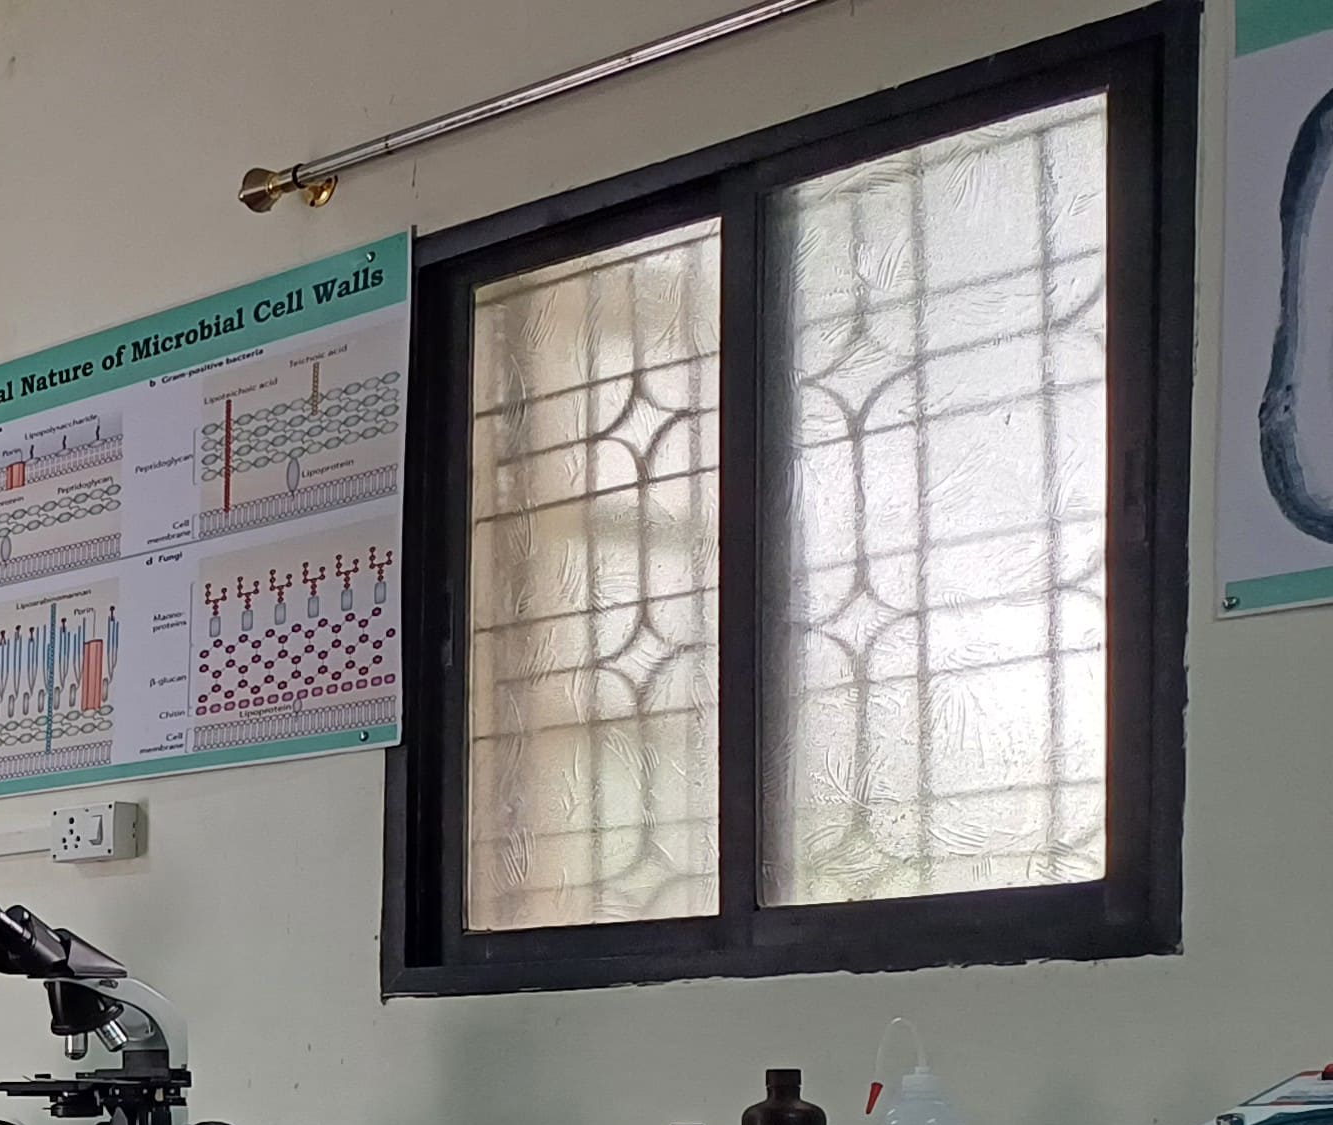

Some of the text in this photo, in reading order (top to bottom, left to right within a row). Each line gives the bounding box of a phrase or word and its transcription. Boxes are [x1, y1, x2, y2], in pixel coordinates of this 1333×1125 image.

[20, 360, 94, 397] Nature
[101, 344, 126, 371] of
[131, 306, 245, 363] Microbial
[253, 287, 304, 323] Cell
[312, 265, 384, 305] Walls
[327, 345, 348, 358] acid
[149, 347, 264, 388] b Gram-positive bacteria
[259, 377, 278, 390] acid
[134, 453, 193, 474] Peptidoglycan
[301, 459, 355, 479] Lipoprotein
[57, 476, 112, 496] Peptidoglycan
[172, 519, 190, 530] Cell
[147, 530, 191, 545] membrane
[146, 551, 183, 566] d Fungi
[73, 606, 94, 617] Porin
[152, 619, 187, 633] proteins
[159, 709, 186, 720] Chitin
[239, 703, 292, 718] Lipoprotein
[166, 732, 183, 742] Cell
[139, 742, 184, 754] membrane
